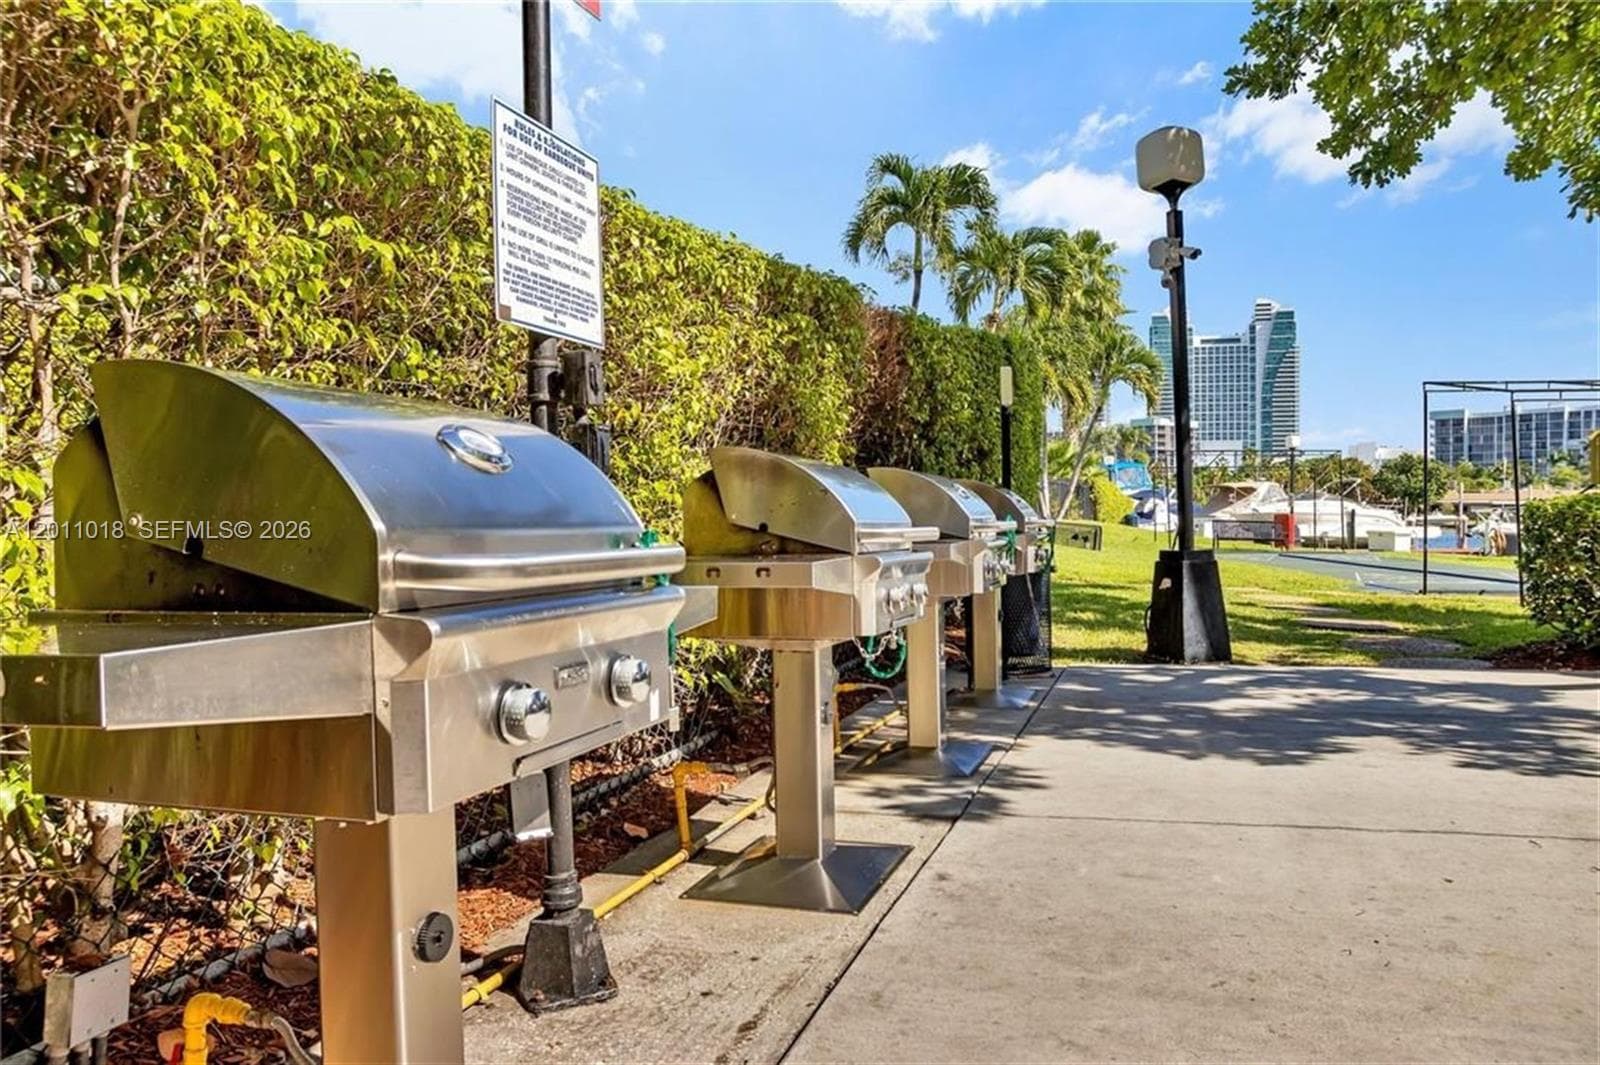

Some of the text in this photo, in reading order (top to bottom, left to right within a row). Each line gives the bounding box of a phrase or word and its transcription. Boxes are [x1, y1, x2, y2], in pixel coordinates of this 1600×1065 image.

[514, 119, 535, 138] RULES
[503, 123, 517, 139] FOR
[519, 132, 531, 147] USE
[533, 140, 541, 153] OF
[516, 148, 523, 157] OF
[524, 176, 531, 185] OF
[528, 232, 534, 242] OF
